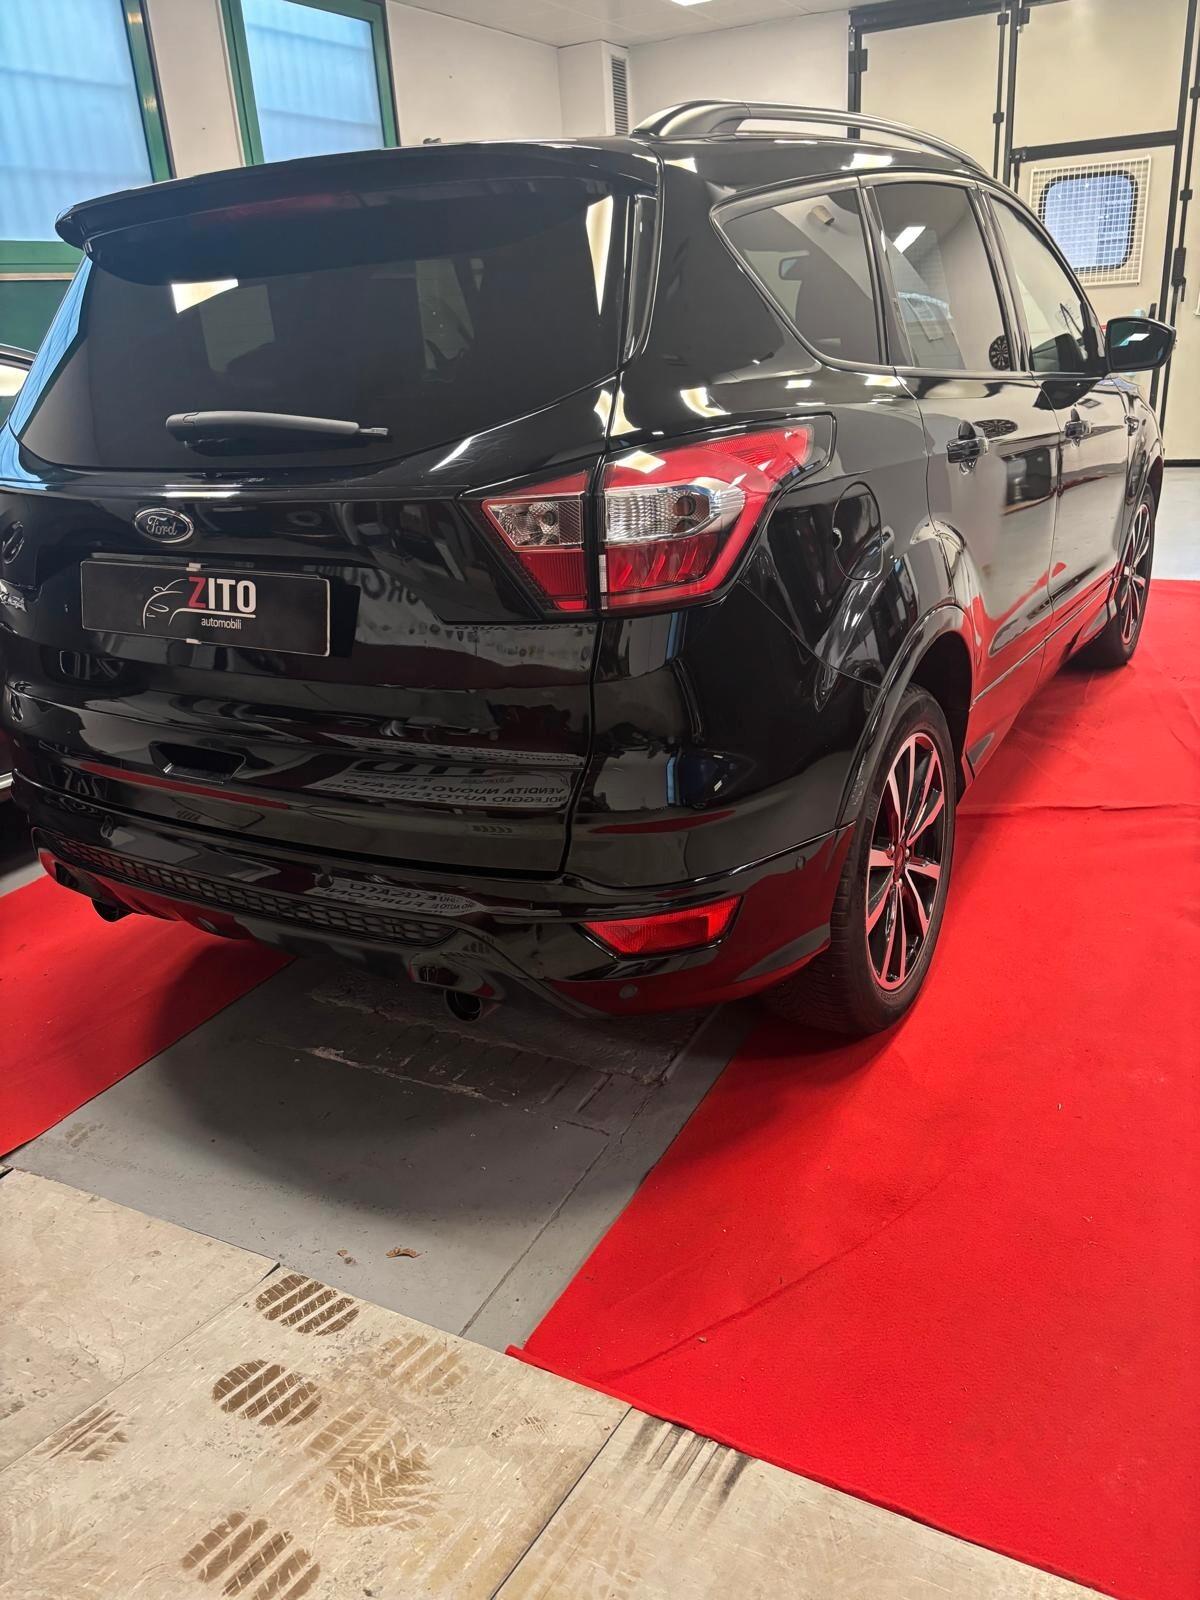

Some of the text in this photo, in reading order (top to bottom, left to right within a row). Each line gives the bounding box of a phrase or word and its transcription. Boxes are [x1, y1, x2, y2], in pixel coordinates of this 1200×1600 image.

[146, 515, 178, 536] Ford
[188, 576, 257, 613] ZITO
[201, 617, 242, 630] automobili
